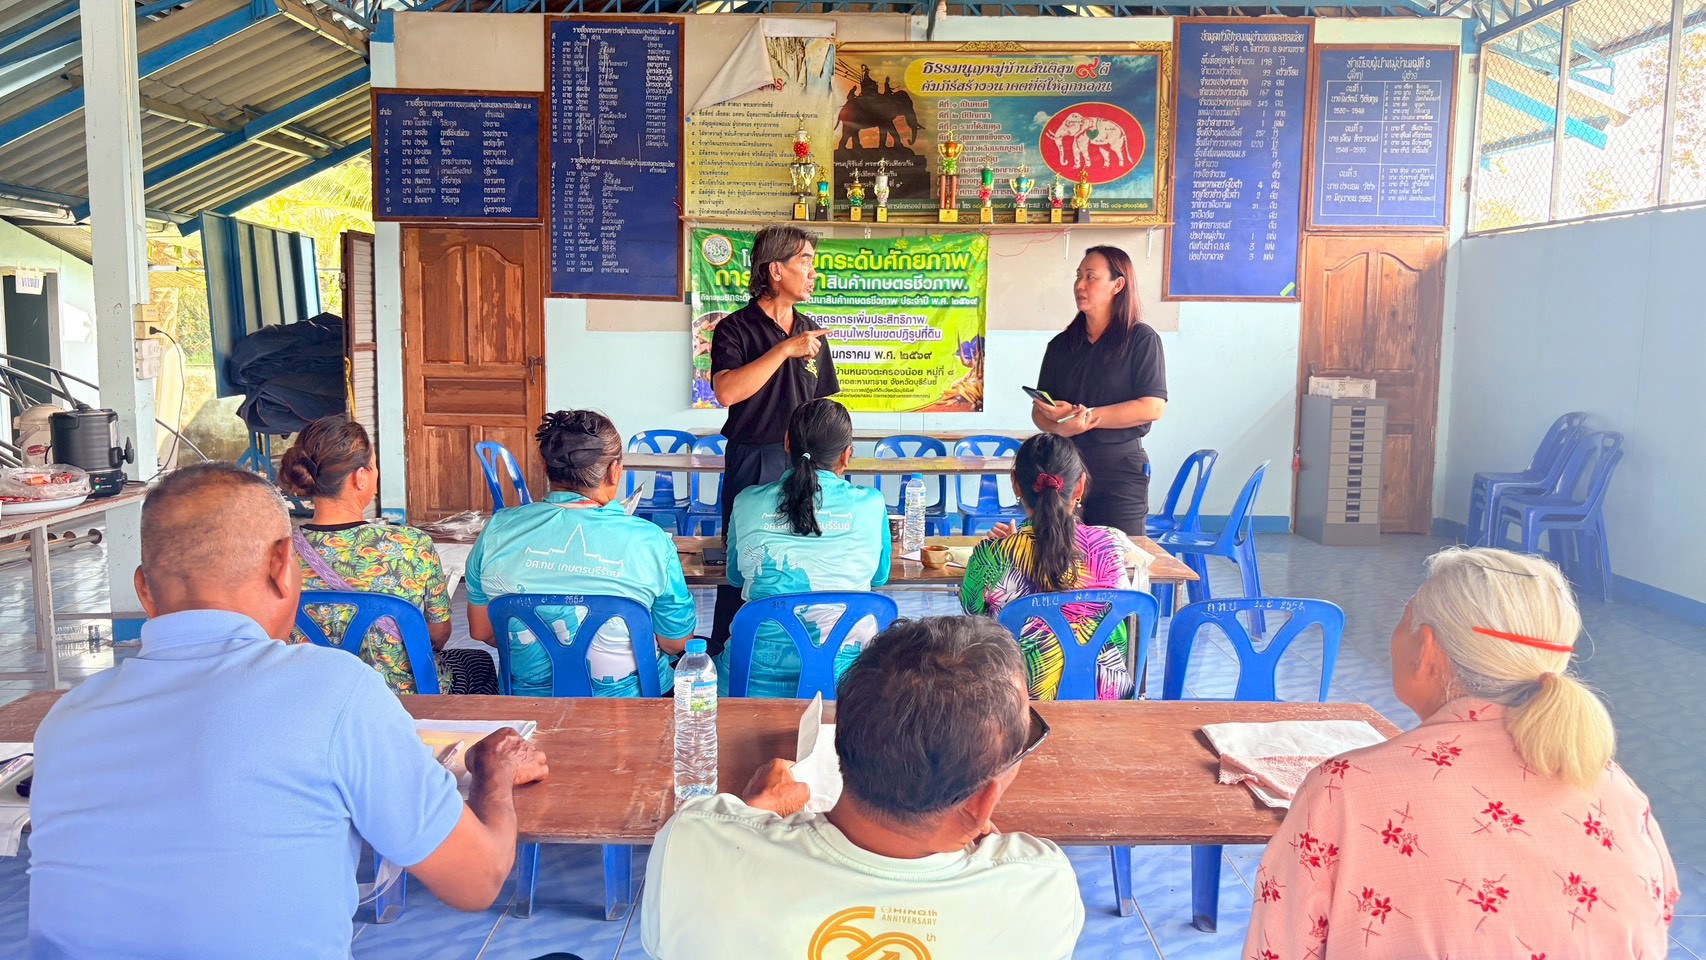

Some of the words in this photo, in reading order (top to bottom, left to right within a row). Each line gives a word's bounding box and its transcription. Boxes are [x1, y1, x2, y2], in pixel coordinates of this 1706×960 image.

[922, 61, 1073, 78] ธรรมนูญหมู่บ้านสันติสุข
[1075, 57, 1099, 78] ๙
[1099, 62, 1109, 76] ดี
[921, 78, 1112, 94] คัมภีร์สร้างอนาคตที่ดีให้ลูกหลาน
[938, 99, 949, 108] ดีที่
[960, 100, 989, 108] เป็นคนดี
[938, 111, 949, 119] ดีที่
[961, 111, 991, 119] มีปัญญา
[960, 121, 1001, 131] รายได้สมดุล
[960, 132, 1011, 142] สุขภาพแข็งแรง
[963, 144, 1024, 153] งแวดล้อมสมบูรณ์
[798, 295, 898, 306] ฒนาสินค้าเกษตรชีวภาพ
[901, 295, 929, 305] ประจำปี
[806, 310, 926, 326] ักสูตรการเพิ่มประสิทธิภาพ
[832, 350, 870, 360] มกราคม
[875, 350, 896, 360] พ.ศ.
[900, 350, 932, 361] ๒๕๖๙
[927, 365, 945, 379] หมู่ที่
[890, 376, 938, 389] จังหวัดบุรีรัมย์
[558, 563, 620, 578] เกษตรบุรีรัมย์
[882, 914, 937, 926] ANNIVERSARY
[927, 933, 936, 942] th
